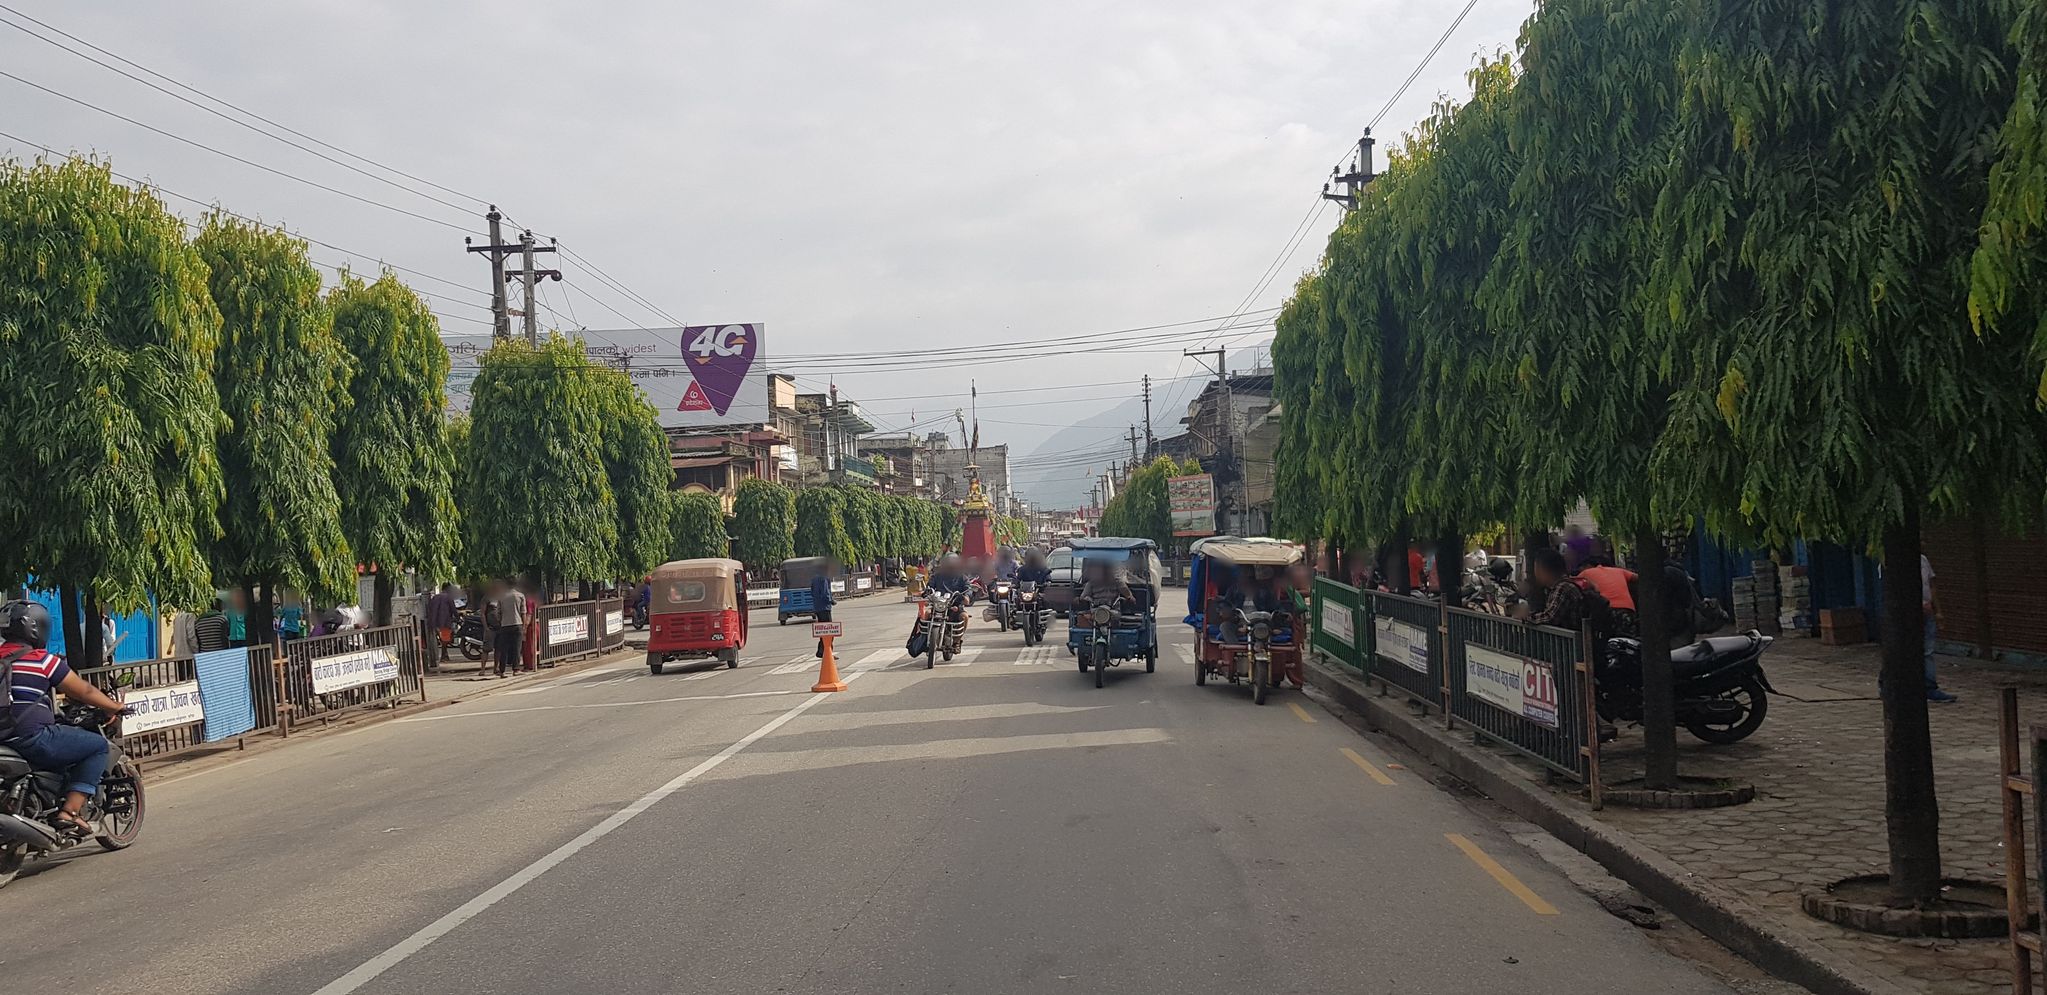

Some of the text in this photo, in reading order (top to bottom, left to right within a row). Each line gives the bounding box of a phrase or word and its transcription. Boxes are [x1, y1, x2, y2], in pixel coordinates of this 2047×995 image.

[621, 344, 656, 354] widest
[689, 325, 746, 357] 4G
[1523, 663, 1553, 702] CIT
[170, 690, 189, 711] जिवन
